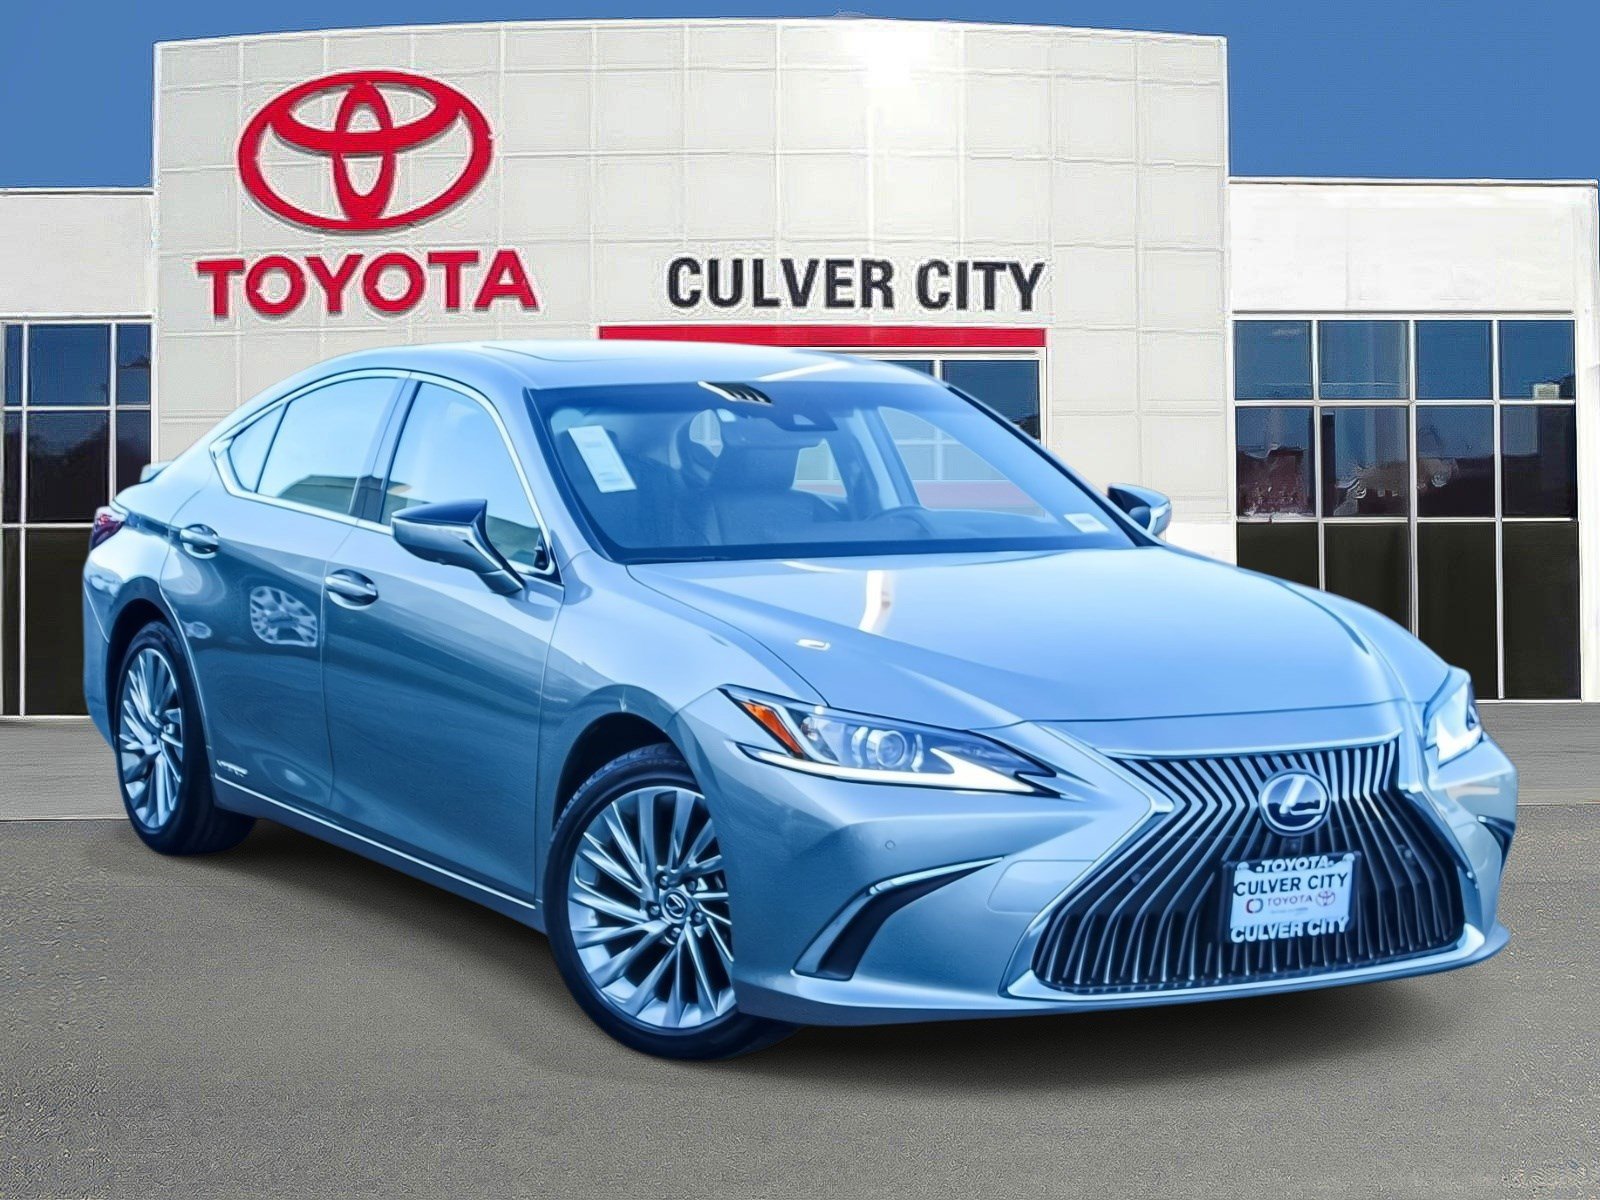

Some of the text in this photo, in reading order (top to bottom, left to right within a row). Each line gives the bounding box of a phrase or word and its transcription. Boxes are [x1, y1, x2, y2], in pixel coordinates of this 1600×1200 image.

[196, 249, 539, 319] TOYOTA
[667, 257, 1045, 312] CULVER CITY
[1260, 855, 1329, 873] TOYOTA
[1234, 872, 1348, 896] CULVER CITY
[1267, 894, 1313, 907] TOYOTA
[1230, 916, 1349, 943] CULVER CITY
